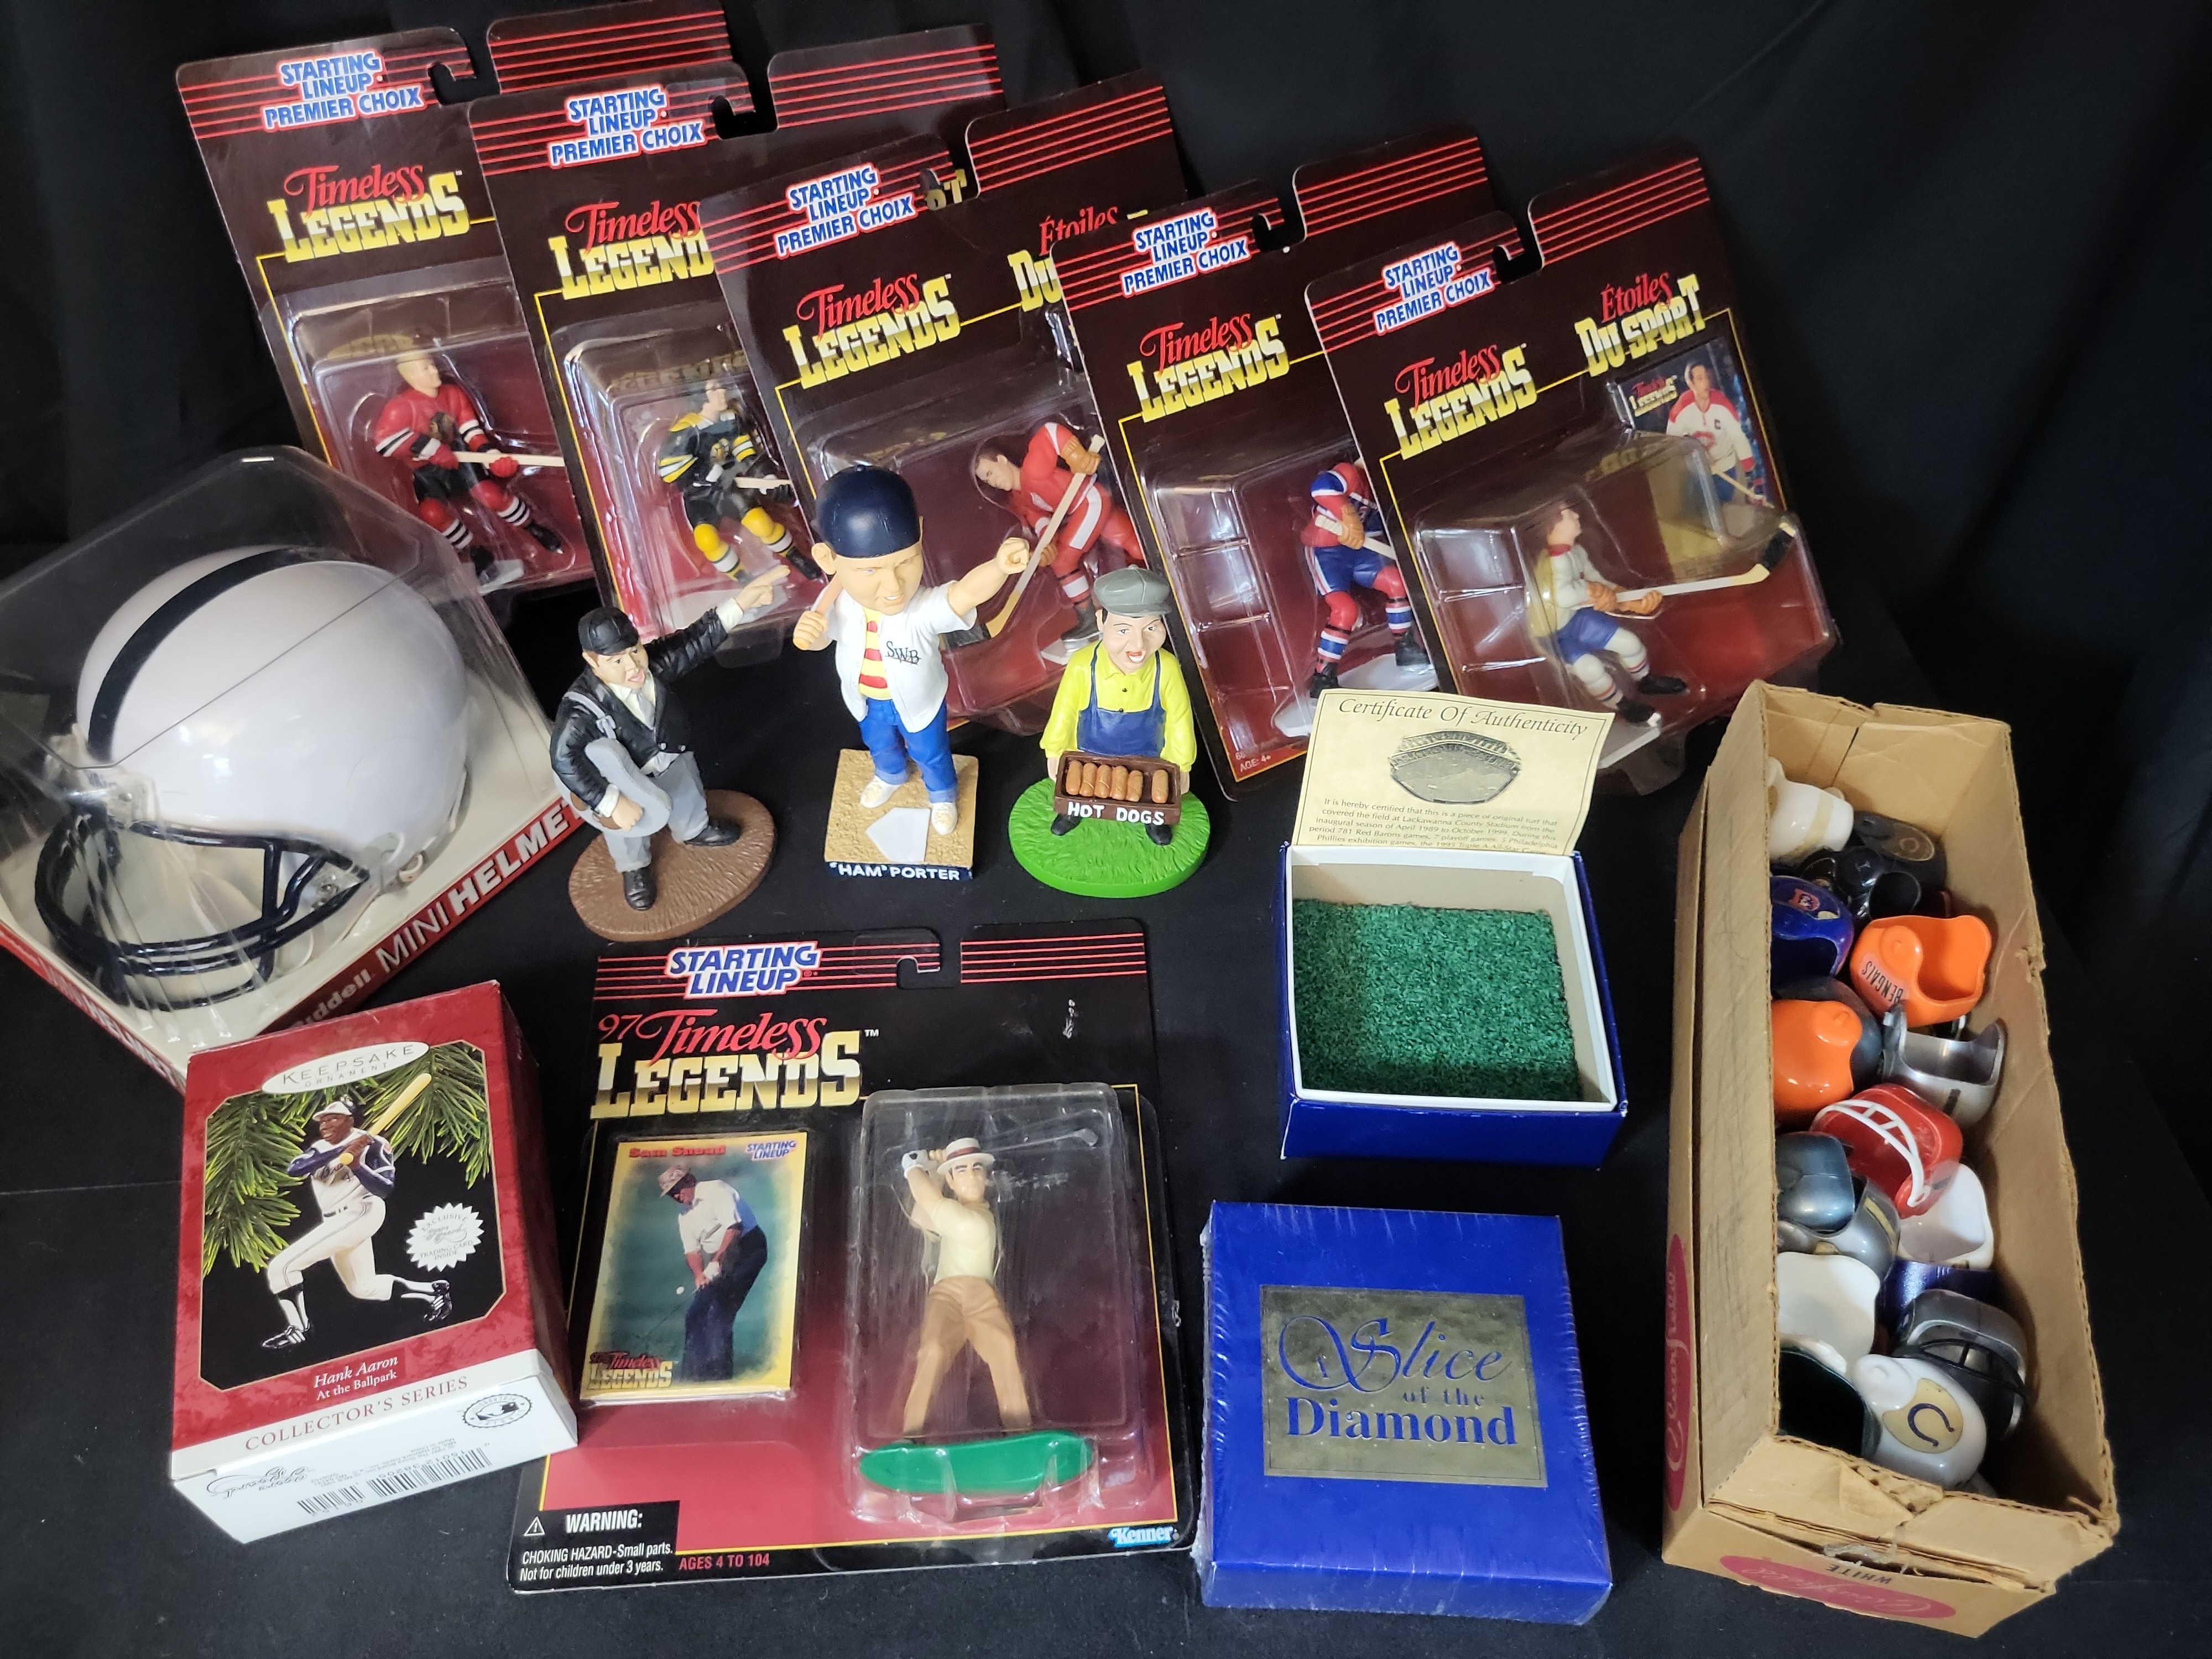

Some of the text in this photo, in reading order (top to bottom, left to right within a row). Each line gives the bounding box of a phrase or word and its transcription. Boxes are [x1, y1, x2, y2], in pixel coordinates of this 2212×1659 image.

[281, 53, 380, 84] STARTING
[303, 75, 372, 99] LINEUP
[265, 87, 422, 128] PREMIER CHOIX
[569, 88, 664, 121] STARTING
[589, 111, 656, 135] LINEUP
[552, 123, 705, 164] PREMIER CHOIX
[284, 165, 425, 218] Timeless
[790, 168, 877, 208] STARTING
[268, 171, 470, 263] LEGENDS
[809, 190, 869, 221] LINEUP
[566, 200, 701, 255] Timeless
[778, 197, 915, 253] PREMIER CHOIX
[1136, 212, 1214, 249] STARTING
[1153, 233, 1208, 262] LINEUP
[549, 229, 714, 300] LEGEND
[1124, 240, 1248, 293] PREMIER CHOIX
[1385, 246, 1458, 287] STARTING
[1402, 267, 1454, 298] LINEUP
[1601, 273, 1672, 322] Étoiles
[796, 274, 920, 340] Timeless
[1376, 270, 1491, 331] PREMIER CHOIX
[783, 276, 961, 388] LEGENDS
[1621, 274, 1706, 359] SPORT
[1139, 314, 1252, 375] Timeless
[1126, 316, 1290, 422] LEGENDS
[1395, 345, 1500, 411] Timeless
[1385, 346, 1537, 460] LEGENDS
[886, 640, 921, 665] SWB
[1339, 698, 1588, 740] Certificate Of Authenticity
[1068, 801, 1164, 825] HOT DOGS
[1316, 816, 1353, 827] inaugural
[1396, 823, 1416, 832] April
[1452, 826, 1483, 835] October
[1512, 831, 1540, 840] During
[1322, 808, 1354, 817] covered
[1357, 811, 1370, 820] the
[1372, 812, 1390, 821] field
[1402, 815, 1452, 826] Lackawanna
[1455, 819, 1483, 828] County
[1486, 820, 1519, 829] Stadium
[1342, 800, 1369, 810] hereby
[1371, 804, 1405, 813] certified
[1407, 806, 1422, 815] that
[1425, 808, 1439, 816] this
[1493, 814, 1524, 823] original
[1542, 818, 1557, 827] that
[1317, 834, 1345, 842] Phillies
[1348, 837, 1387, 846] exhibition
[1441, 834, 1469, 843] playoff
[1509, 837, 1557, 849] Philadelphia
[890, 866, 960, 880] PORTER
[375, 901, 450, 975] MINI
[669, 946, 817, 974] STARTING
[690, 969, 797, 994] LINEUP
[1861, 961, 1903, 1004] BENGALS
[636, 1009, 827, 1067] Timeless
[283, 1045, 414, 1085] KEEPSAKE
[305, 1062, 387, 1087] ORNAMENT
[590, 1029, 879, 1120] LEGENDS TM
[629, 1147, 667, 1159] Sam
[747, 1140, 796, 1152] STARTING
[753, 1148, 790, 1160] LINEUP
[421, 1213, 468, 1232] EXCLUSIVE
[420, 1239, 473, 1259] TRADING CARD
[435, 1250, 457, 1260] INSIDE
[1279, 1316, 1513, 1392] Slice
[313, 1354, 399, 1388] Hank Aaron
[316, 1370, 398, 1401] At the Ballpark
[588, 1361, 673, 1389] LEGENDS
[1402, 1386, 1485, 1407] of the
[245, 1376, 468, 1451] COLLECTOR'S SERIES
[1287, 1396, 1517, 1446] Diamond
[566, 1509, 643, 1533] WARNING:
[1110, 1525, 1173, 1545] Kenner
[523, 1548, 568, 1564] CHOKING
[646, 1541, 673, 1558] parts.
[679, 1552, 770, 1571] AGES 4 TO 104
[520, 1559, 664, 1582] Not for children under 3 years.
[1827, 1563, 1892, 1584] WHITE
